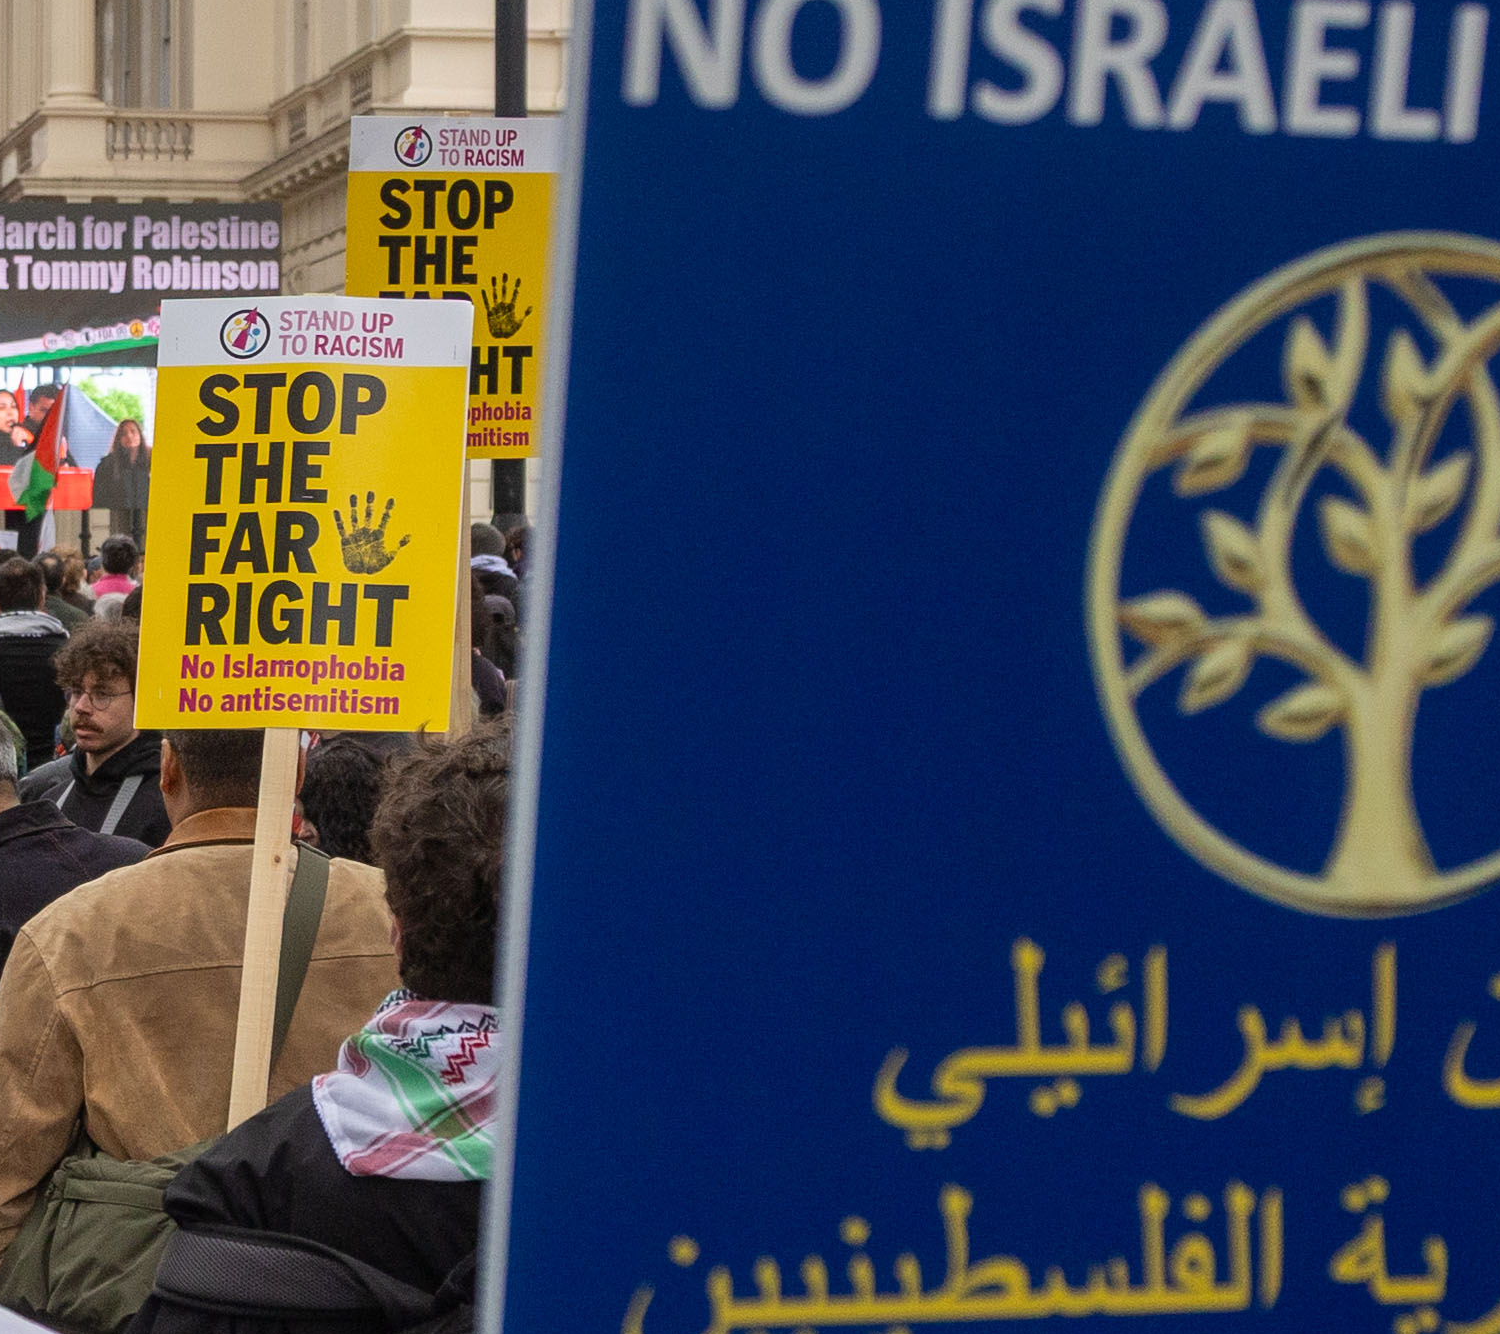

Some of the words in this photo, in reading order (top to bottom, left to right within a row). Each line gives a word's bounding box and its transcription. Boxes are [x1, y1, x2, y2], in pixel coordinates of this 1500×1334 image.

[439, 129, 491, 146] STAND
[495, 130, 517, 147] UP
[439, 150, 460, 166] TO
[464, 149, 524, 166] RACISM
[378, 178, 514, 230] STOP
[83, 216, 126, 250] for
[133, 216, 279, 250] Palestine
[14, 255, 126, 294] Tommy
[133, 255, 279, 290] Robinson
[378, 235, 478, 285] THE
[279, 310, 355, 332] STAND
[362, 313, 393, 334] UP
[280, 335, 307, 355] TO
[314, 335, 404, 358] RACISM
[197, 372, 386, 436] STOP
[195, 441, 331, 505] THE
[189, 510, 320, 576] FAR
[184, 580, 410, 648] RIGHT
[181, 655, 216, 680] No
[223, 655, 406, 685] Islamophobia
[179, 688, 213, 712] No
[220, 688, 400, 715] antisemitism
